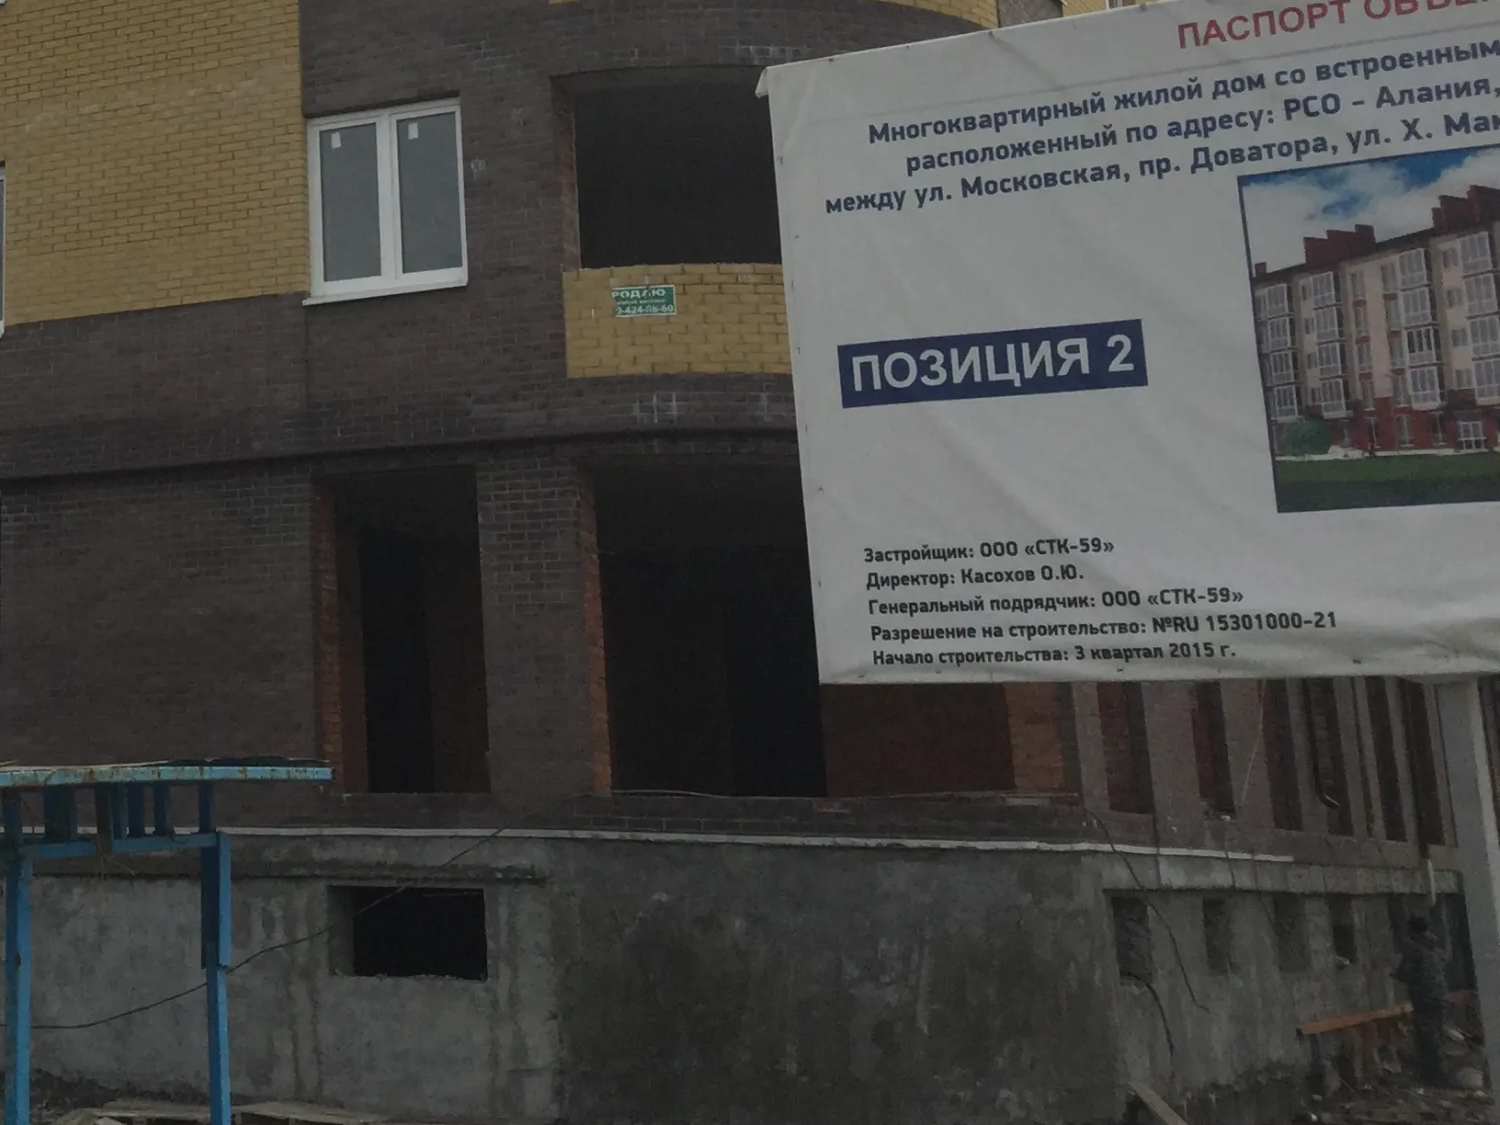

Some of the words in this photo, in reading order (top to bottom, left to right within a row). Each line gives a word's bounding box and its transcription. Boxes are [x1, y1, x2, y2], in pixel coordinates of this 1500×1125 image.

[868, 92, 1106, 144] Многоквартирный
[1113, 78, 1202, 111] жилой
[1211, 72, 1266, 100] дом
[1274, 67, 1306, 87] со
[1315, 39, 1500, 80] встроенным
[905, 124, 1118, 176] расположенный
[1125, 123, 1158, 144] по
[1166, 108, 1275, 139] адресу:
[1283, 92, 1341, 121] РСО
[825, 189, 906, 214] между
[913, 185, 952, 209] ул.
[960, 163, 1131, 199] Московская,
[1138, 155, 1181, 180] пр.
[1190, 134, 1339, 175] Доватора,
[1346, 126, 1391, 154] ул.
[1401, 116, 1433, 142] Х.
[852, 337, 1090, 392] ПОЗИЦИЯ
[1106, 334, 1134, 373] 2
[863, 544, 974, 565] Застройщик:
[979, 540, 1018, 558] ООО
[1024, 537, 1115, 556] «СТК-59»
[866, 572, 955, 591] Директор:
[960, 568, 1036, 584] Касохов
[1040, 563, 1084, 581] О.Ю.
[868, 595, 985, 617] Генеральный
[989, 593, 1096, 613] подрядчик:
[1101, 589, 1141, 607] ООО
[1147, 586, 1244, 606] «СТК-59»
[871, 625, 977, 644] Разрешение
[982, 624, 1004, 638] на
[1008, 621, 1147, 641] строительство:
[1151, 615, 1199, 634] №RU
[1205, 611, 1337, 632] 15301000-21
[872, 650, 934, 665] Начало
[938, 648, 1069, 667] строительства:
[1074, 645, 1086, 661] 3
[1090, 645, 1164, 663] квартал
[1168, 642, 1215, 659] 2015
[1220, 643, 1237, 658] г.
